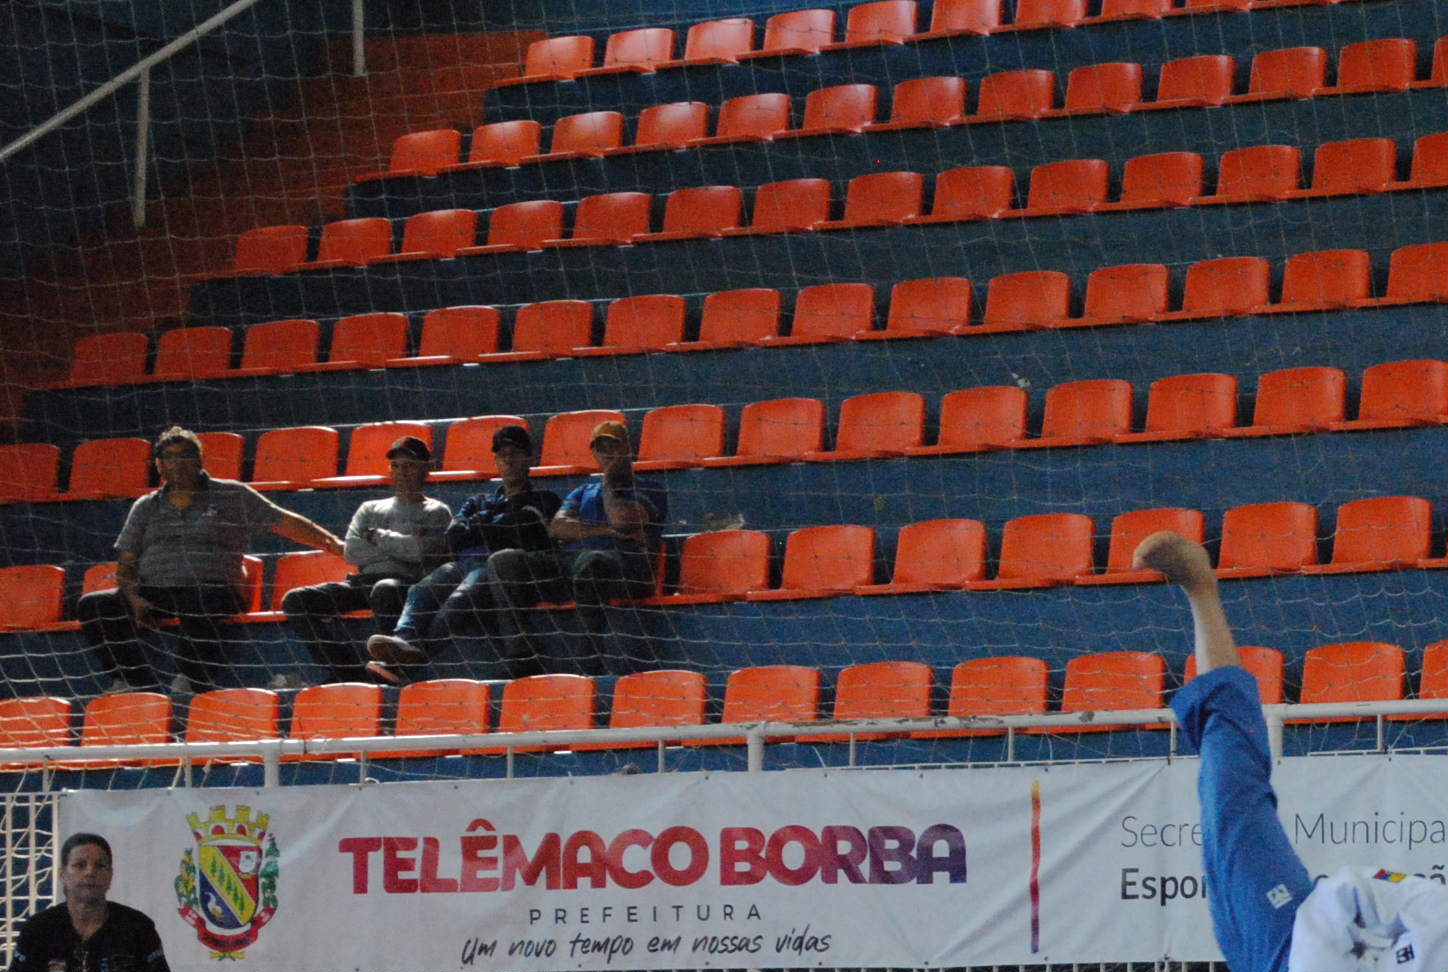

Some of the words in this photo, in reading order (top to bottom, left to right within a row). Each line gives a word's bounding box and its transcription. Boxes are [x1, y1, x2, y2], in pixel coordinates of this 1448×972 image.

[1120, 815, 1203, 848] Secre
[338, 818, 709, 894] TELÊMACO
[719, 824, 967, 886] BORBA
[529, 904, 762, 926] PREFEITURA
[461, 936, 497, 966] Um
[508, 939, 558, 958] novo
[569, 932, 635, 965] tempo
[646, 935, 682, 954] em
[691, 934, 764, 955] nossas
[775, 923, 833, 957] vidas
